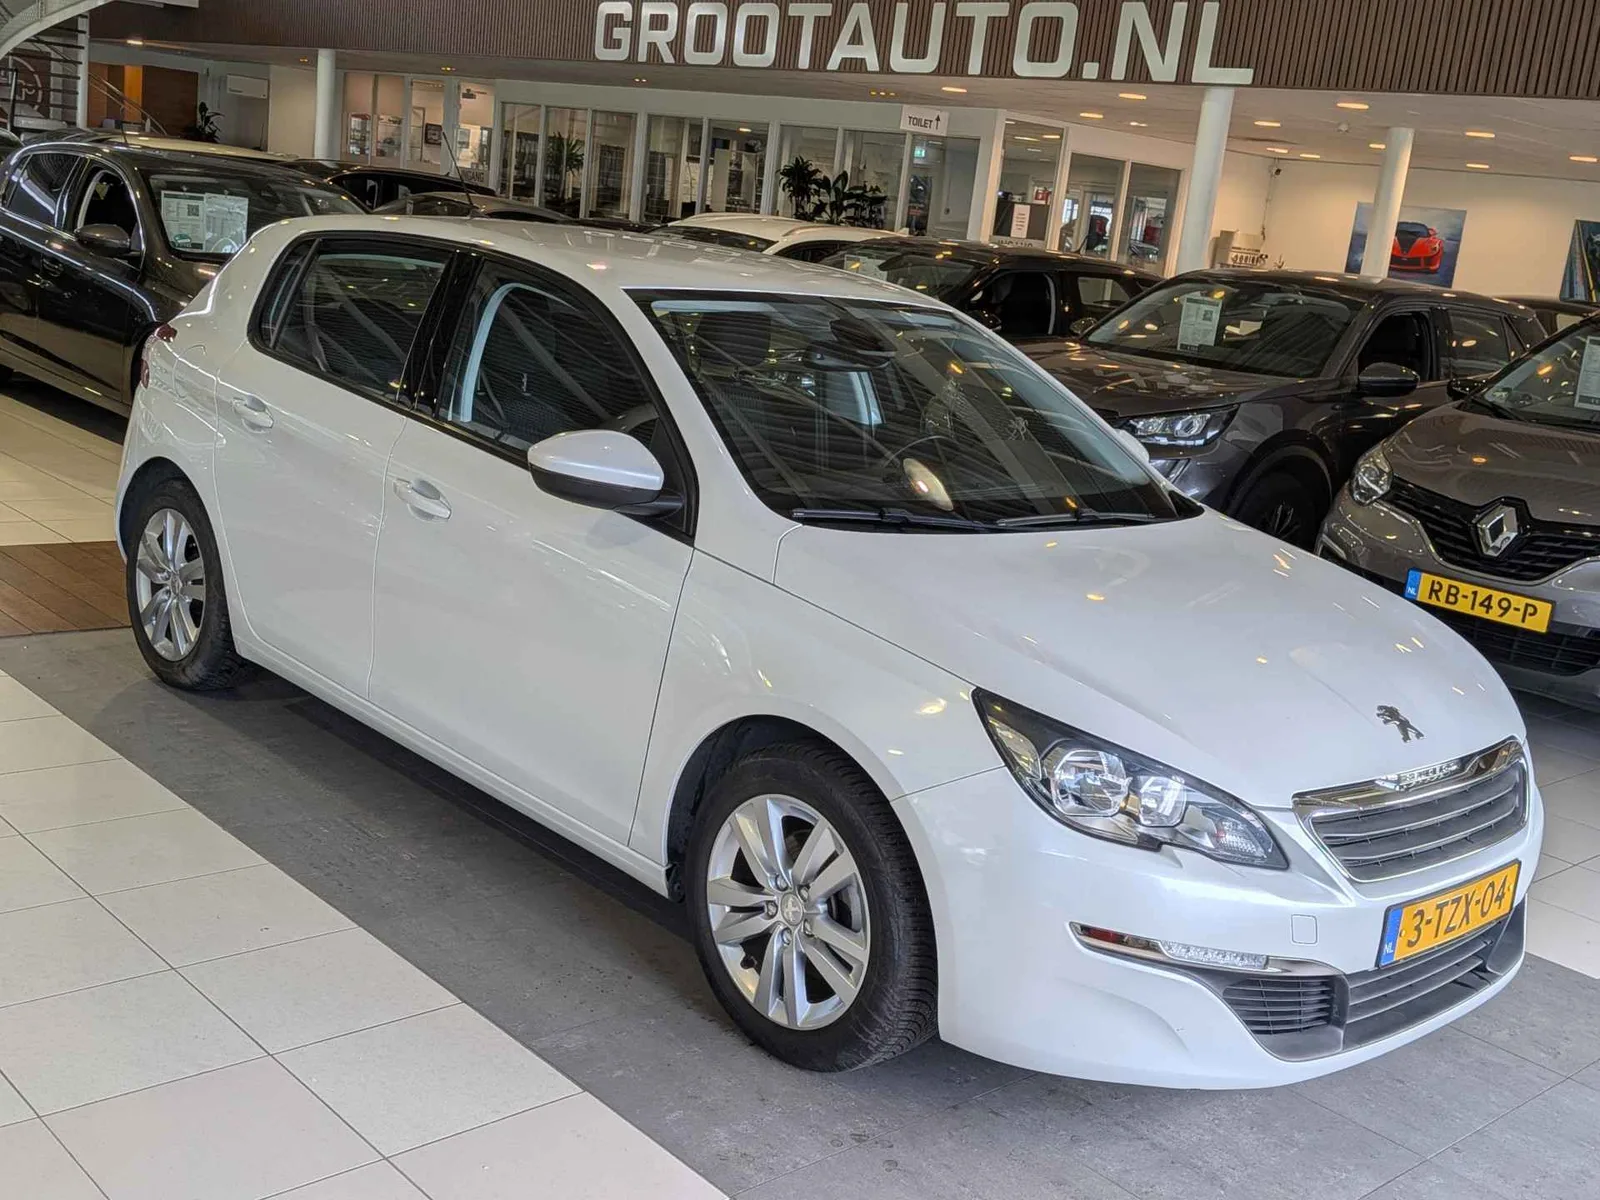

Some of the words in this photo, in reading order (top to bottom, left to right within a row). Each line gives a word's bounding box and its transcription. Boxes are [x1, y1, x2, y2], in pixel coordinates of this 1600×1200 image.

[594, 1, 1255, 85] GROOTAUTO.NL
[908, 115, 933, 129] TOILET
[1407, 586, 1416, 596] NL
[1428, 579, 1538, 623] RB-149-P
[1407, 874, 1508, 948] 3-TZX-04
[1384, 942, 1394, 955] NL
